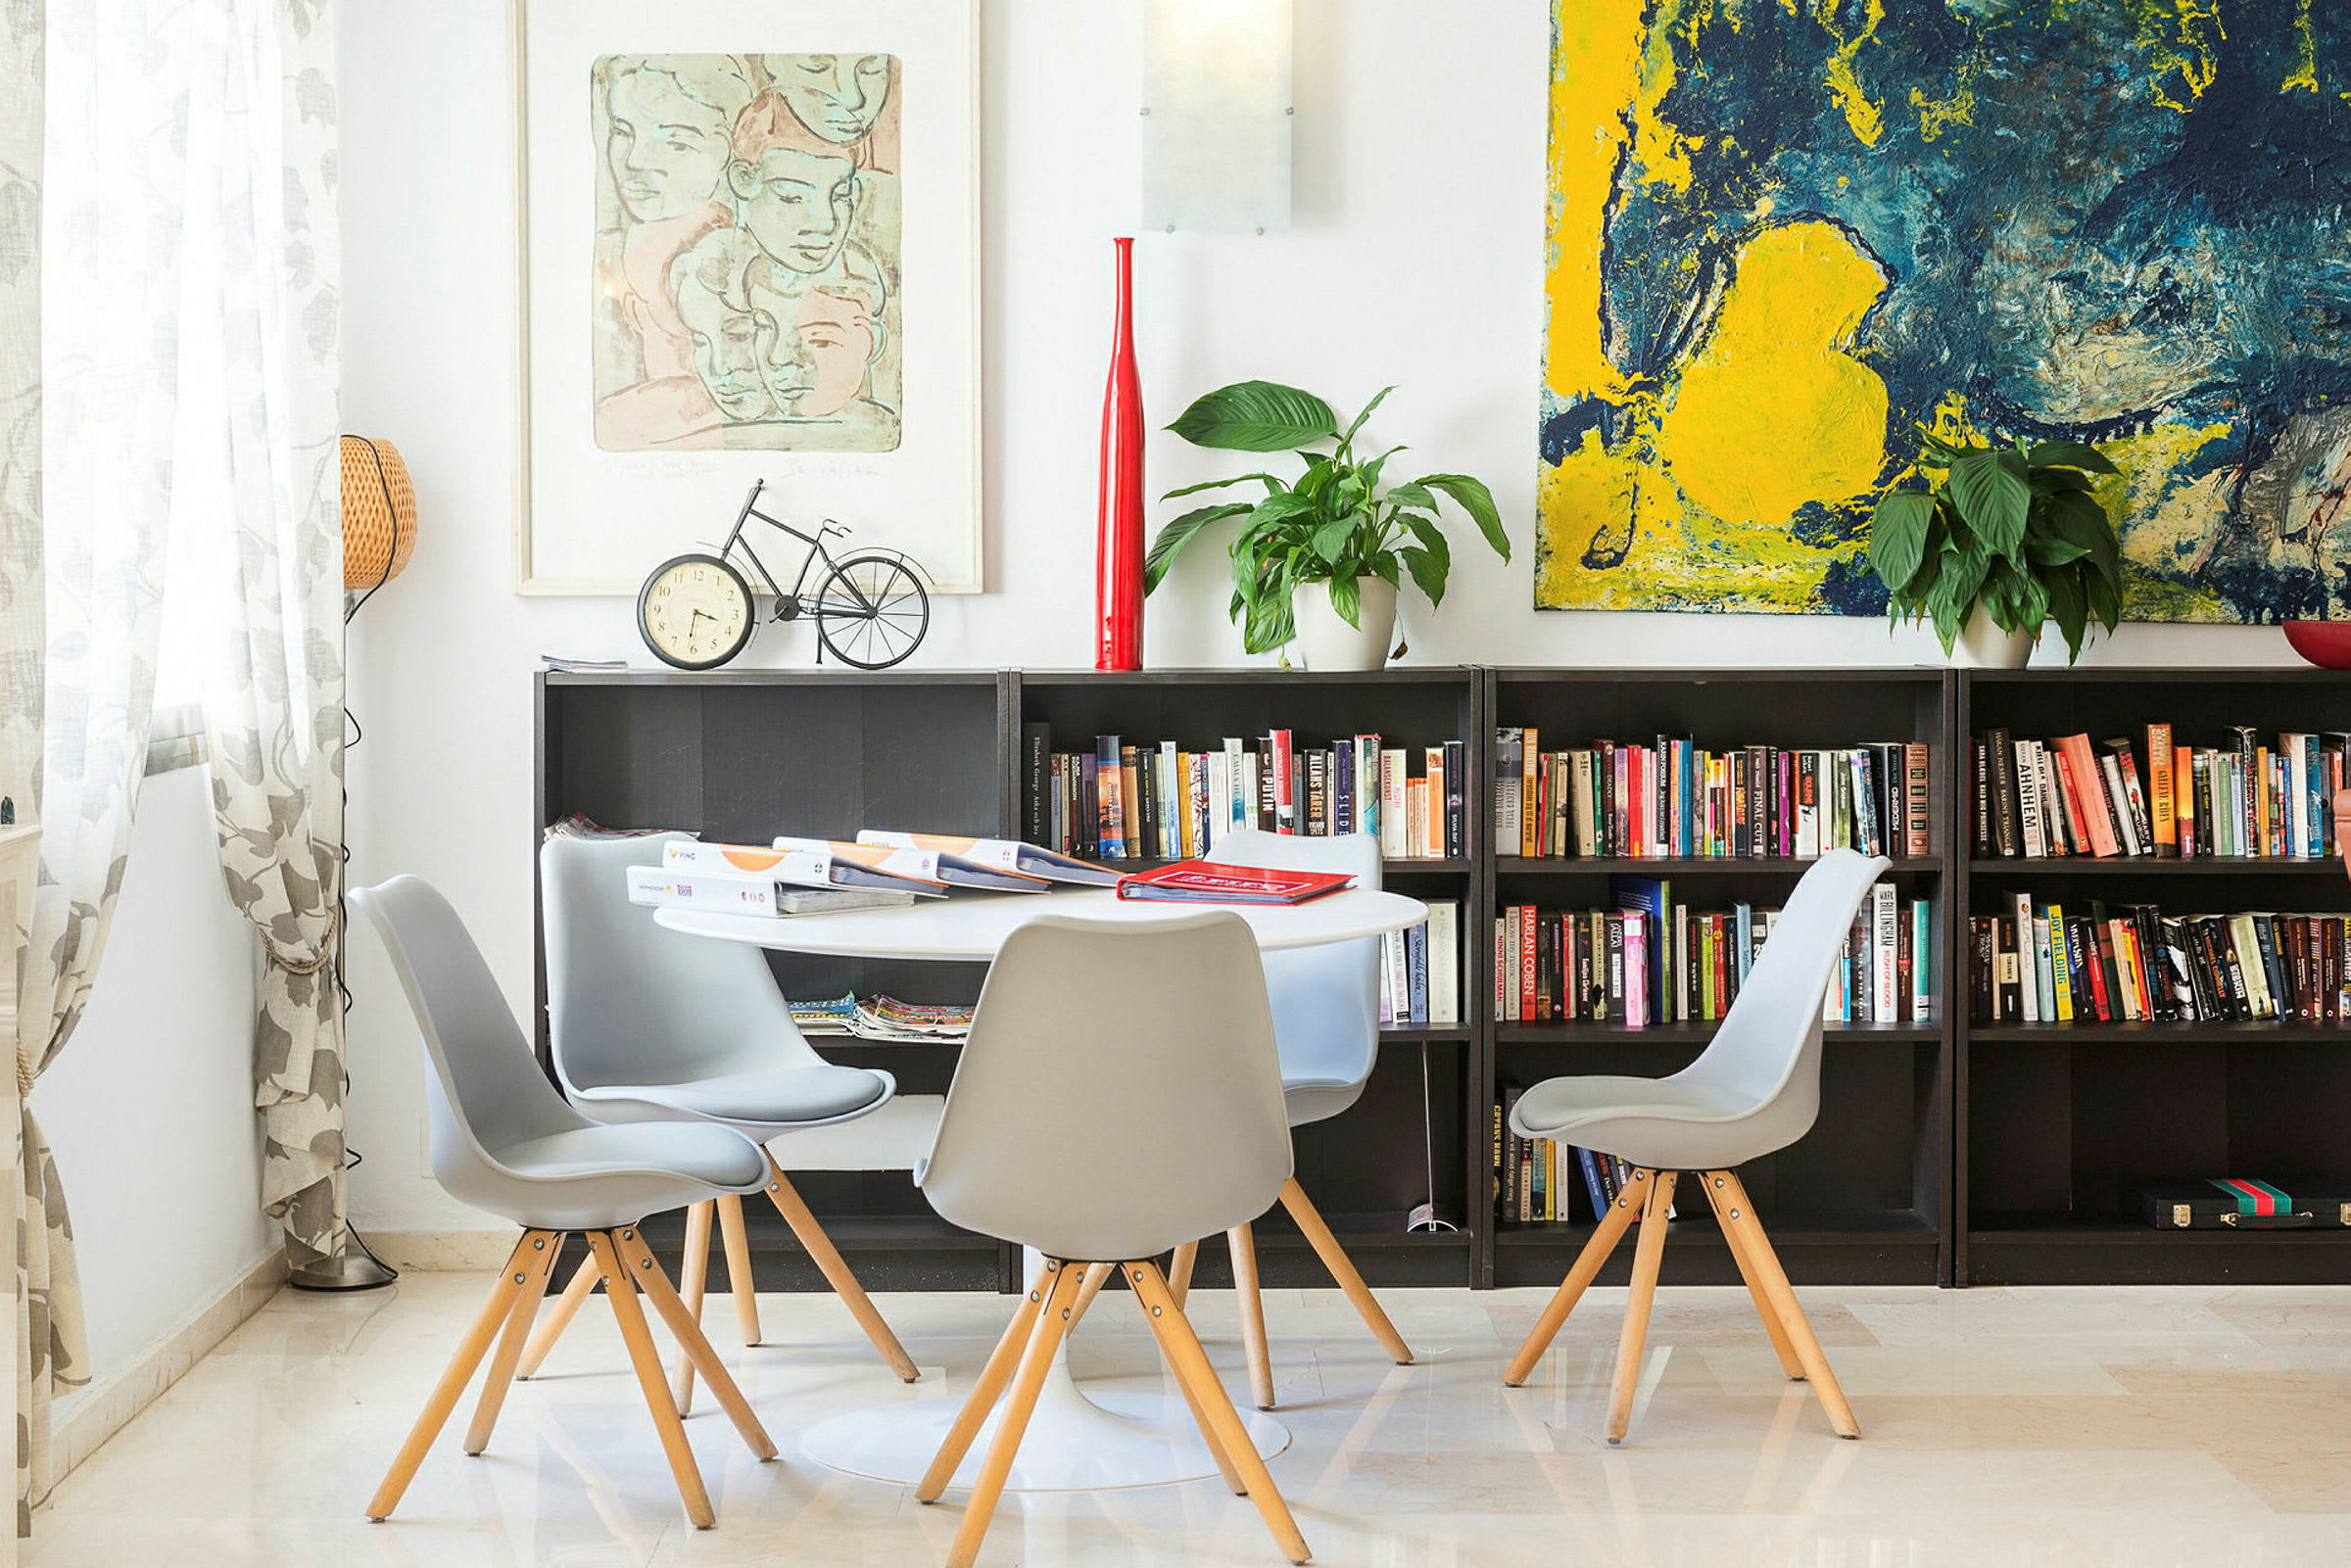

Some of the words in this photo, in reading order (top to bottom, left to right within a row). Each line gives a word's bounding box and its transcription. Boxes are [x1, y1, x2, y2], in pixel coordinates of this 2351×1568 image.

[674, 573, 683, 583] 11
[694, 570, 704, 581] 12
[717, 576, 720, 586] 1
[659, 586, 671, 596] 10
[727, 590, 734, 601] 2
[654, 605, 661, 614] 9
[732, 610, 739, 621] 3
[658, 621, 666, 632] 8
[725, 626, 731, 636] 4
[671, 636, 678, 646] 7
[710, 639, 718, 650] 5
[689, 644, 698, 655] 6
[1310, 755, 1322, 788] ALLAHS
[1997, 757, 2005, 784] NESSER
[1032, 768, 1041, 791] George
[1262, 777, 1274, 812] PUTIN
[2019, 764, 2036, 828] AHNHEM
[1310, 790, 1324, 818] TÅRER
[1754, 791, 1763, 820] FINAL
[1754, 823, 1763, 844] CUT
[1880, 902, 1895, 947] BILLINGHAM
[2050, 913, 2061, 932] JOY
[1524, 909, 1535, 954] HARLAN
[2053, 936, 2067, 984] FIELDING
[1524, 957, 1535, 995] COBEN
[1884, 971, 1892, 980] OF
